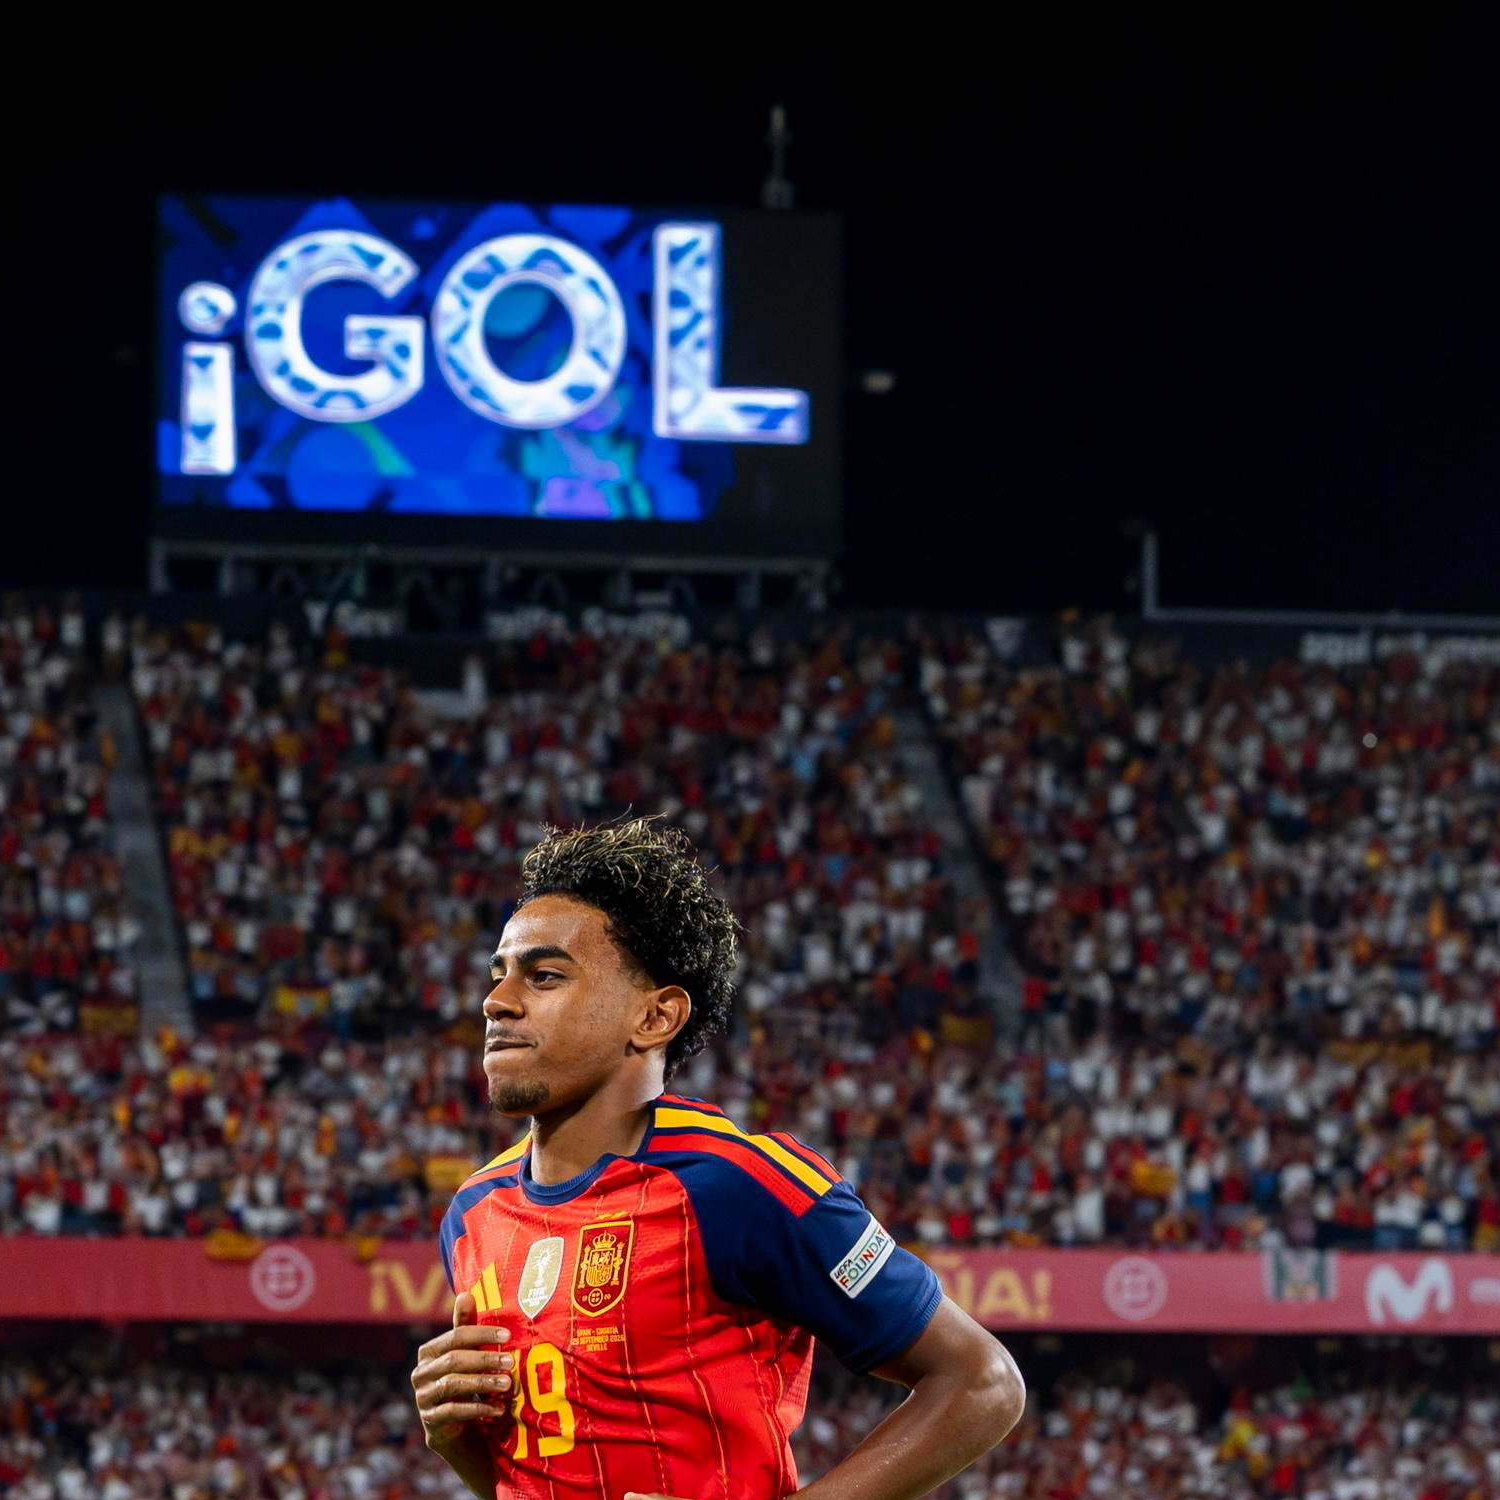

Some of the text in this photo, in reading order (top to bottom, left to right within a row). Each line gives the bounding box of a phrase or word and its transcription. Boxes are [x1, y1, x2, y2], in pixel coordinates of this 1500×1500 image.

[178, 222, 810, 475] ¡GOL
[833, 1258, 854, 1279] UEFA
[512, 1342, 575, 1460] 19
